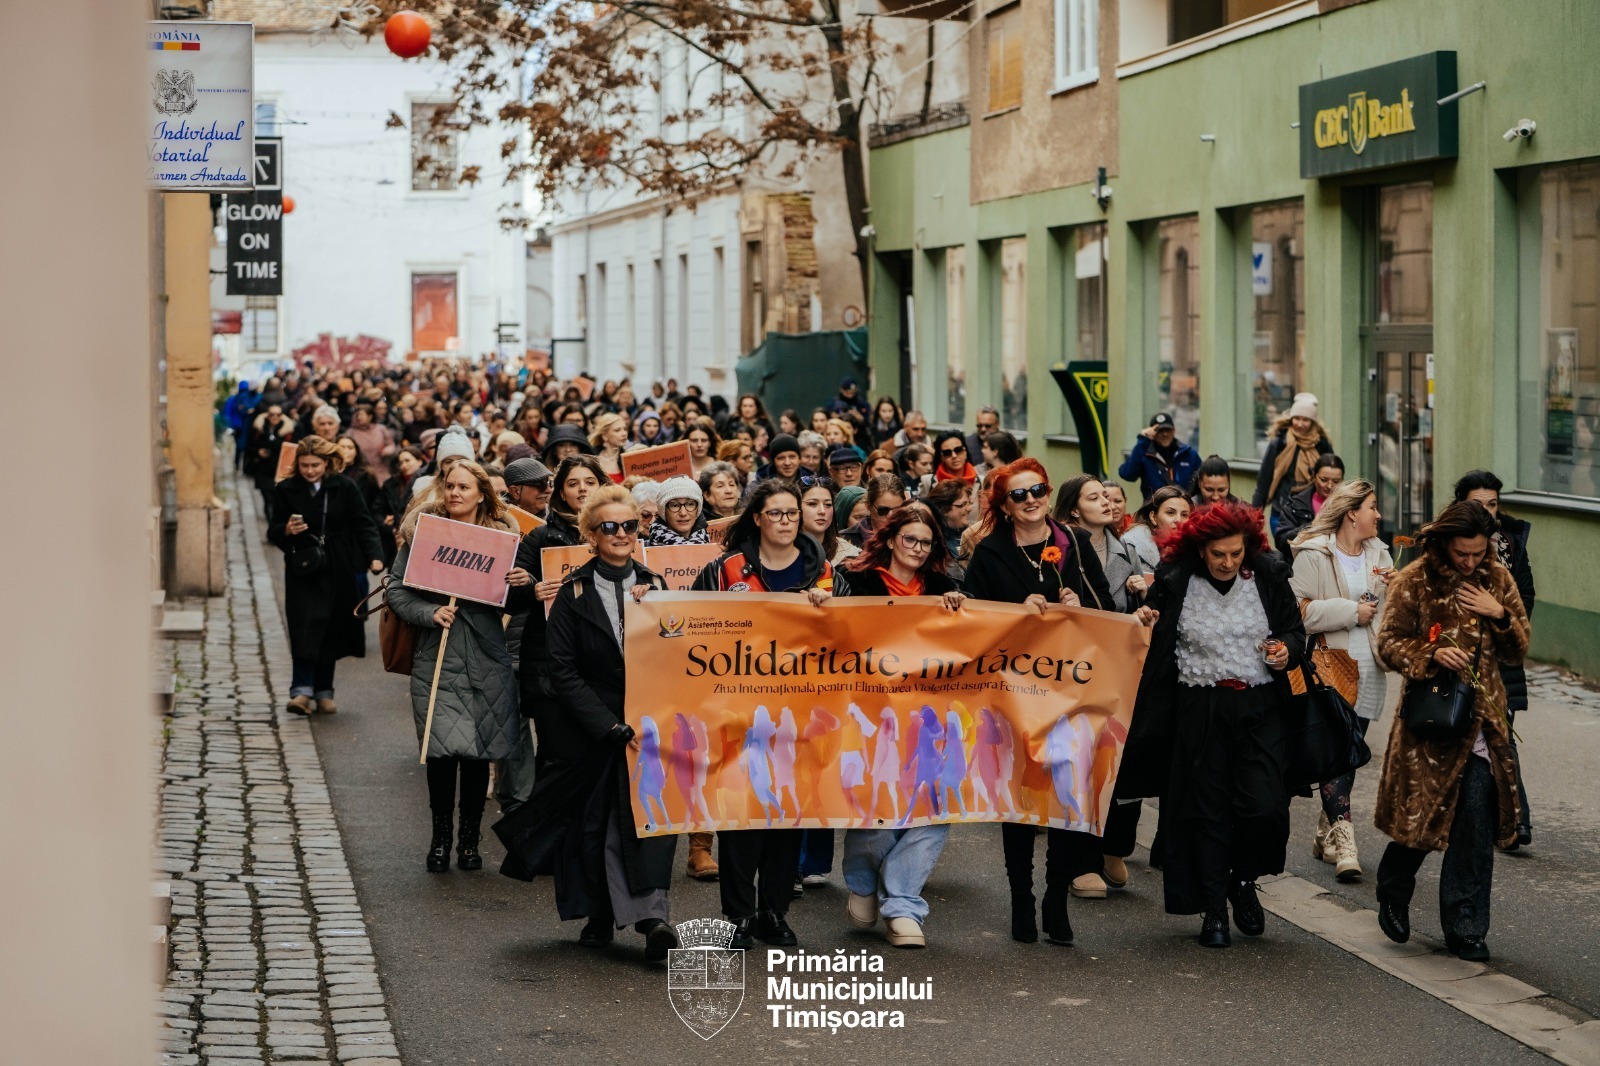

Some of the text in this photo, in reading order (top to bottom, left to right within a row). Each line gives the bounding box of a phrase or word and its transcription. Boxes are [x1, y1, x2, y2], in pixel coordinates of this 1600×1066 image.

[1314, 88, 1415, 148] CEC Bank
[152, 120, 245, 140] Individual
[191, 167, 247, 182] Andrada
[227, 204, 282, 221] GLOW
[239, 232, 270, 250] ON
[233, 261, 278, 279] TIME
[631, 460, 660, 471] Rupem
[431, 545, 496, 574] MARINA
[724, 619, 753, 628] Socială
[686, 639, 1093, 685] Solidaritate, nu tăcere
[713, 683, 737, 694] Ziua
[739, 681, 816, 696] Internațională
[817, 681, 853, 695] pentru
[855, 681, 911, 694] Eliminarea
[961, 681, 998, 692] asupra
[1000, 681, 1050, 697] Femeilor
